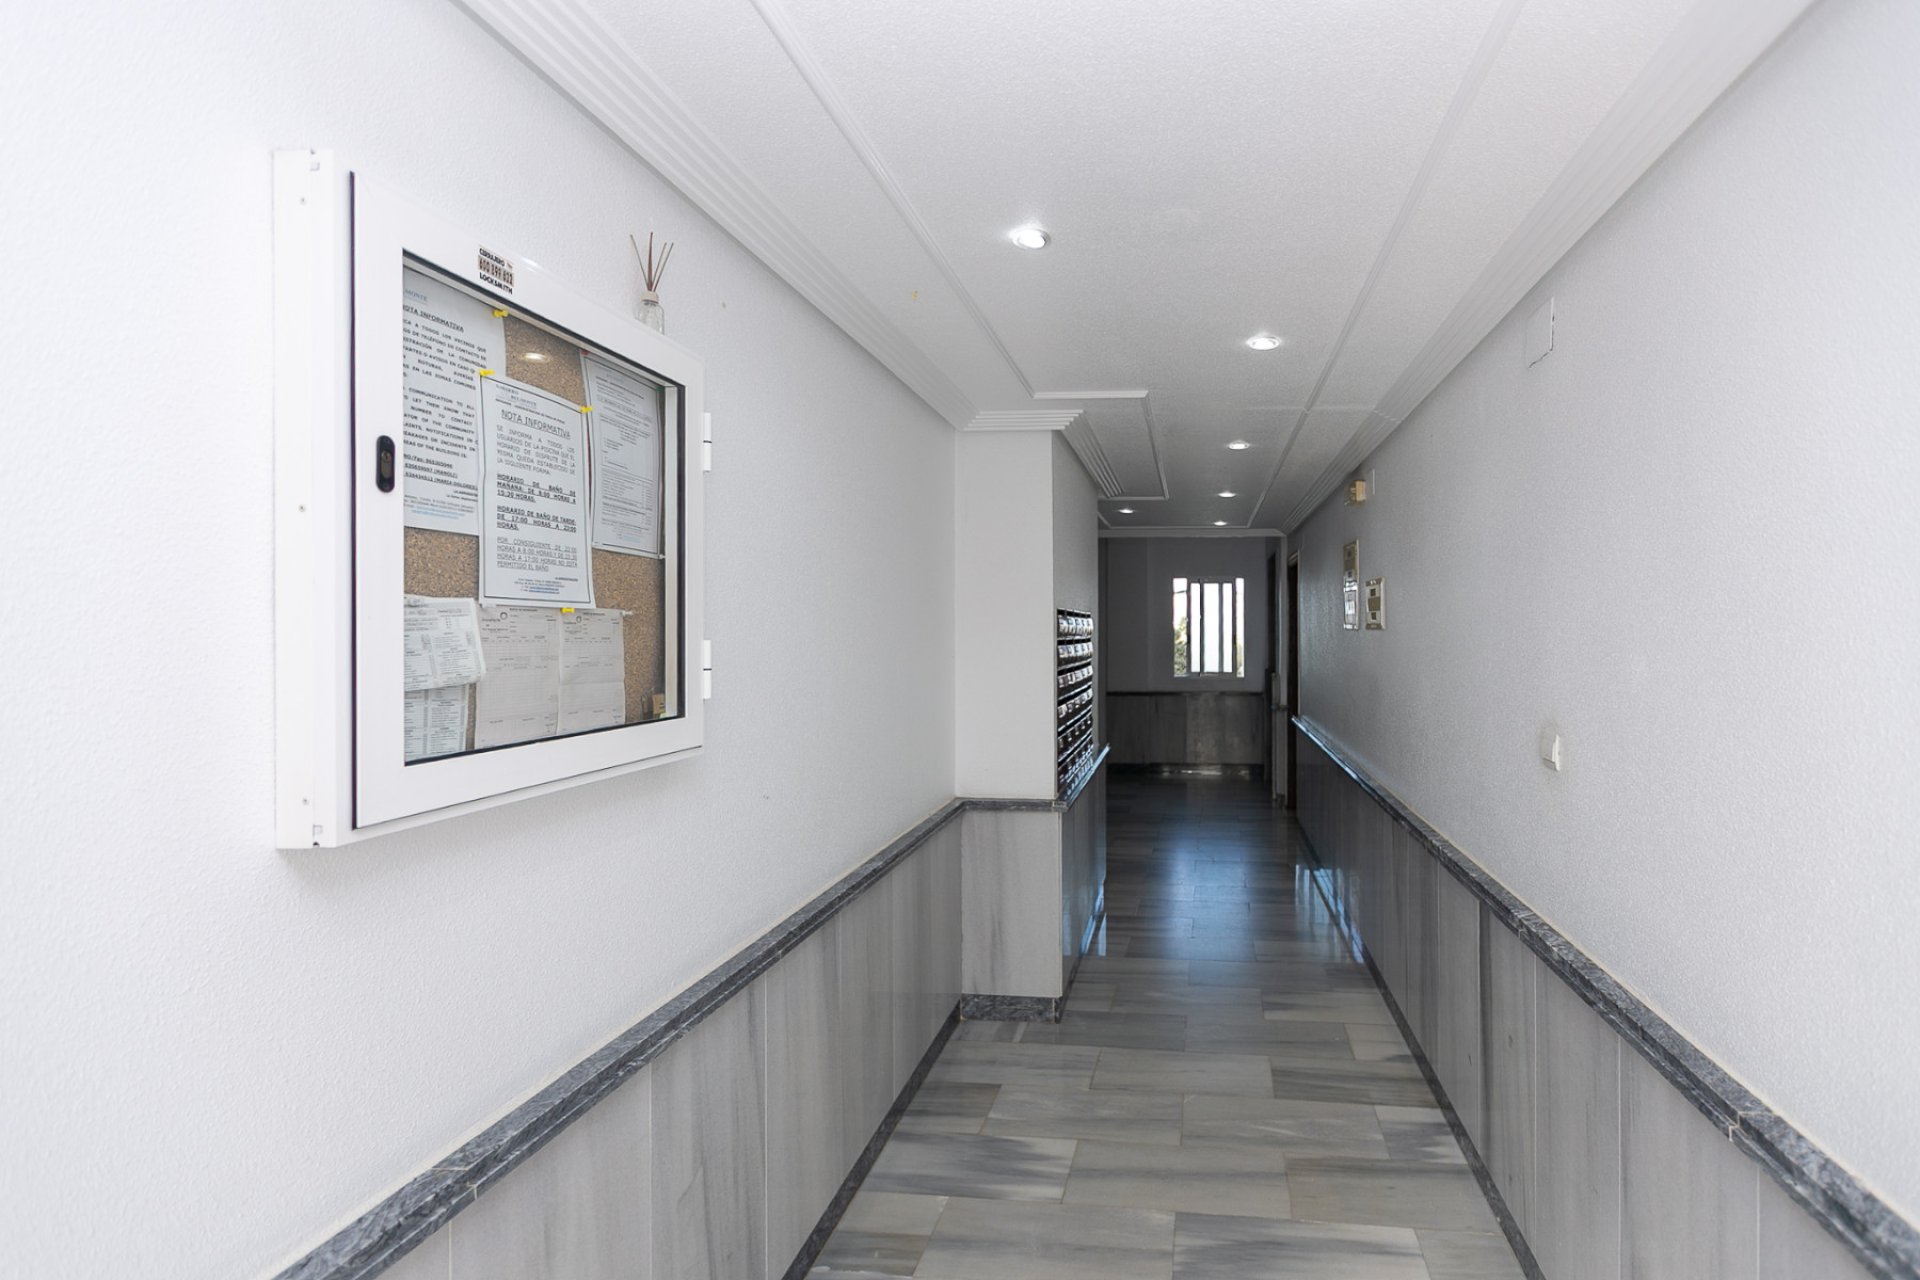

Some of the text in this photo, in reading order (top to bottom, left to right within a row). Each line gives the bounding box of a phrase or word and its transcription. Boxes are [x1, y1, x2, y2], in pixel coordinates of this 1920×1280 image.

[480, 272, 512, 294] LOCKSMITH
[420, 311, 464, 333] INFORMATIVA
[501, 409, 523, 425] NOTA
[525, 417, 571, 439] INFORMATIVA
[497, 433, 522, 446] USUARIOS
[541, 446, 560, 456] PISCINA
[509, 429, 532, 441] INFORMA
[548, 440, 562, 450] TODOS
[497, 442, 520, 453] HORARIO
[535, 452, 558, 463] DISFRUTE
[497, 450, 513, 459] MISMA
[516, 455, 534, 464] QUEDA
[504, 459, 531, 471] SIGUIENTE
[497, 473, 524, 485] HORARIO
[549, 483, 563, 494] BAÑO
[554, 494, 570, 503] HORAS
[497, 505, 525, 516] HORARIO
[536, 511, 551, 521] BAÑO
[533, 520, 551, 529] HORAS
[497, 545, 516, 553] HORAS
[497, 553, 516, 561] HORAS
[498, 561, 527, 570] PERMITIDO
